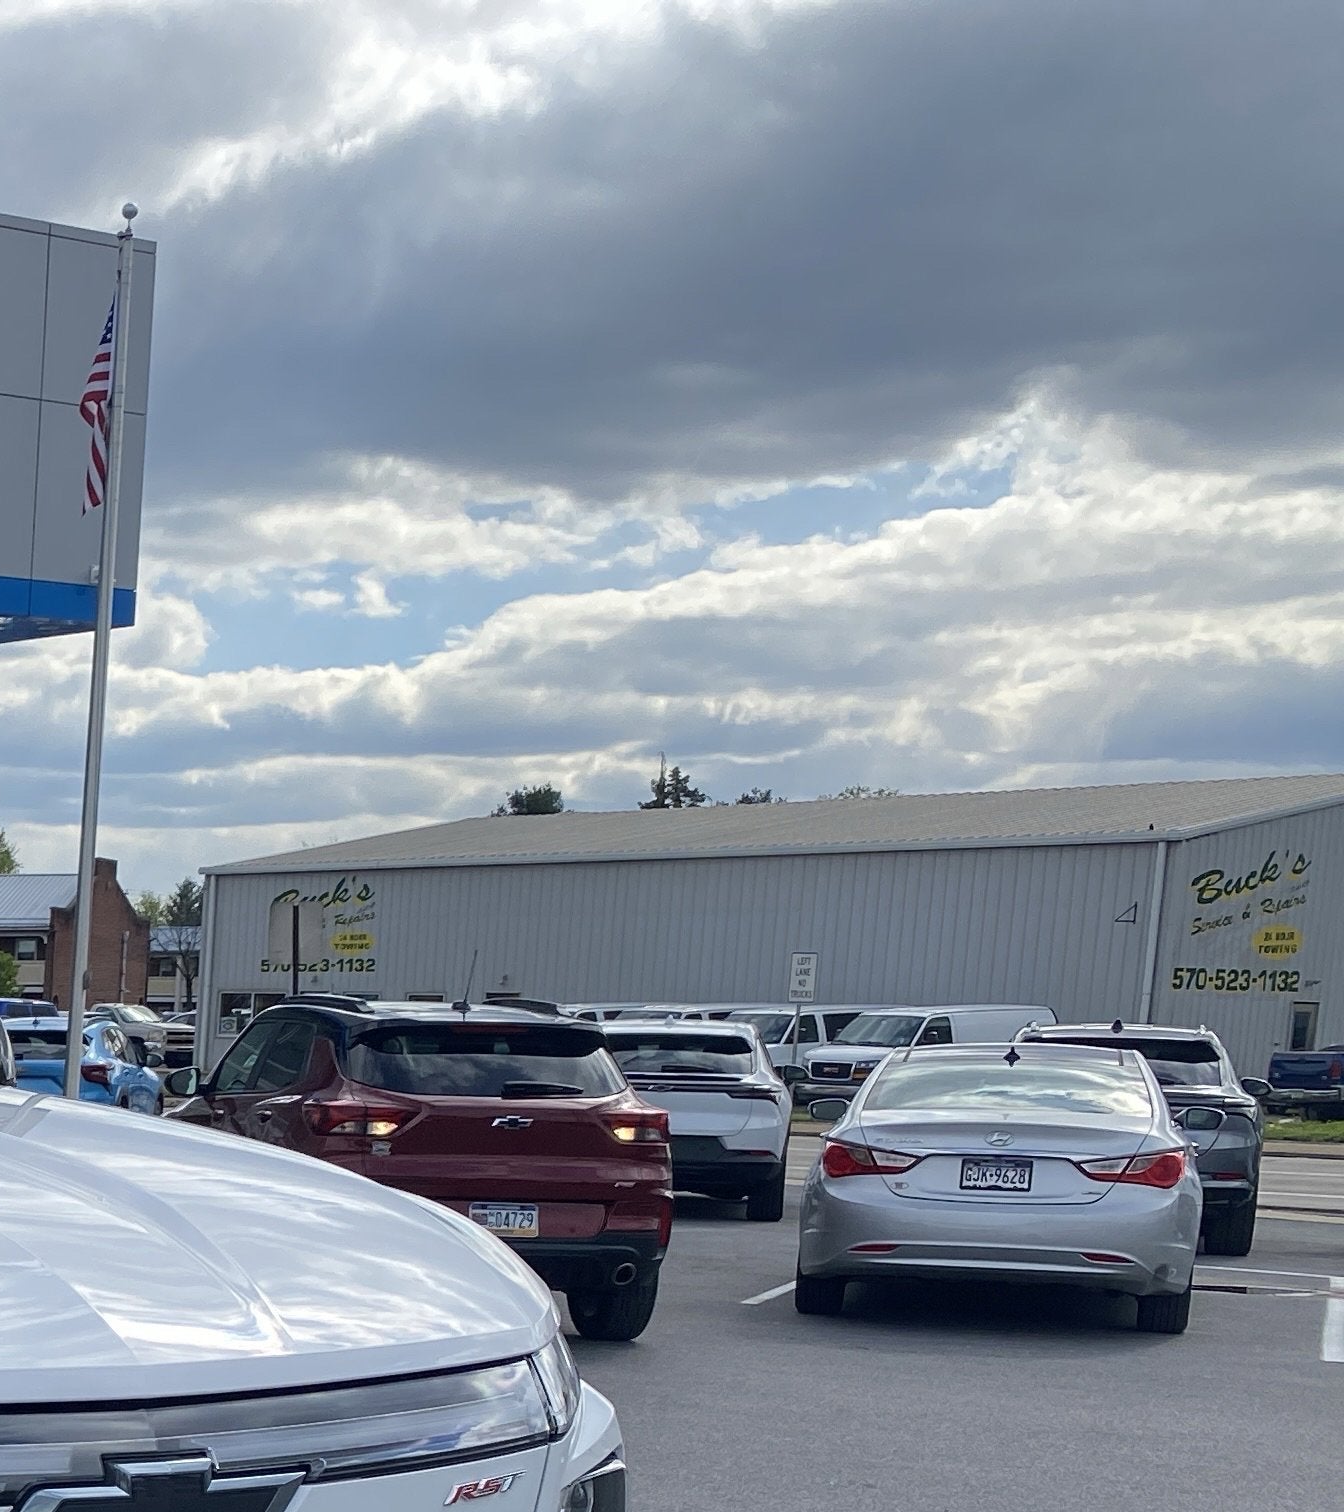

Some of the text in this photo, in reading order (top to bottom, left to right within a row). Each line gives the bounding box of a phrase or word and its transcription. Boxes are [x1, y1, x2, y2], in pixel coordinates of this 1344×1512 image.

[1191, 850, 1312, 904] Buck's
[1258, 944, 1298, 954] TOWING
[1172, 967, 1301, 992] 570-523-1132
[443, 1469, 527, 1507] RST
